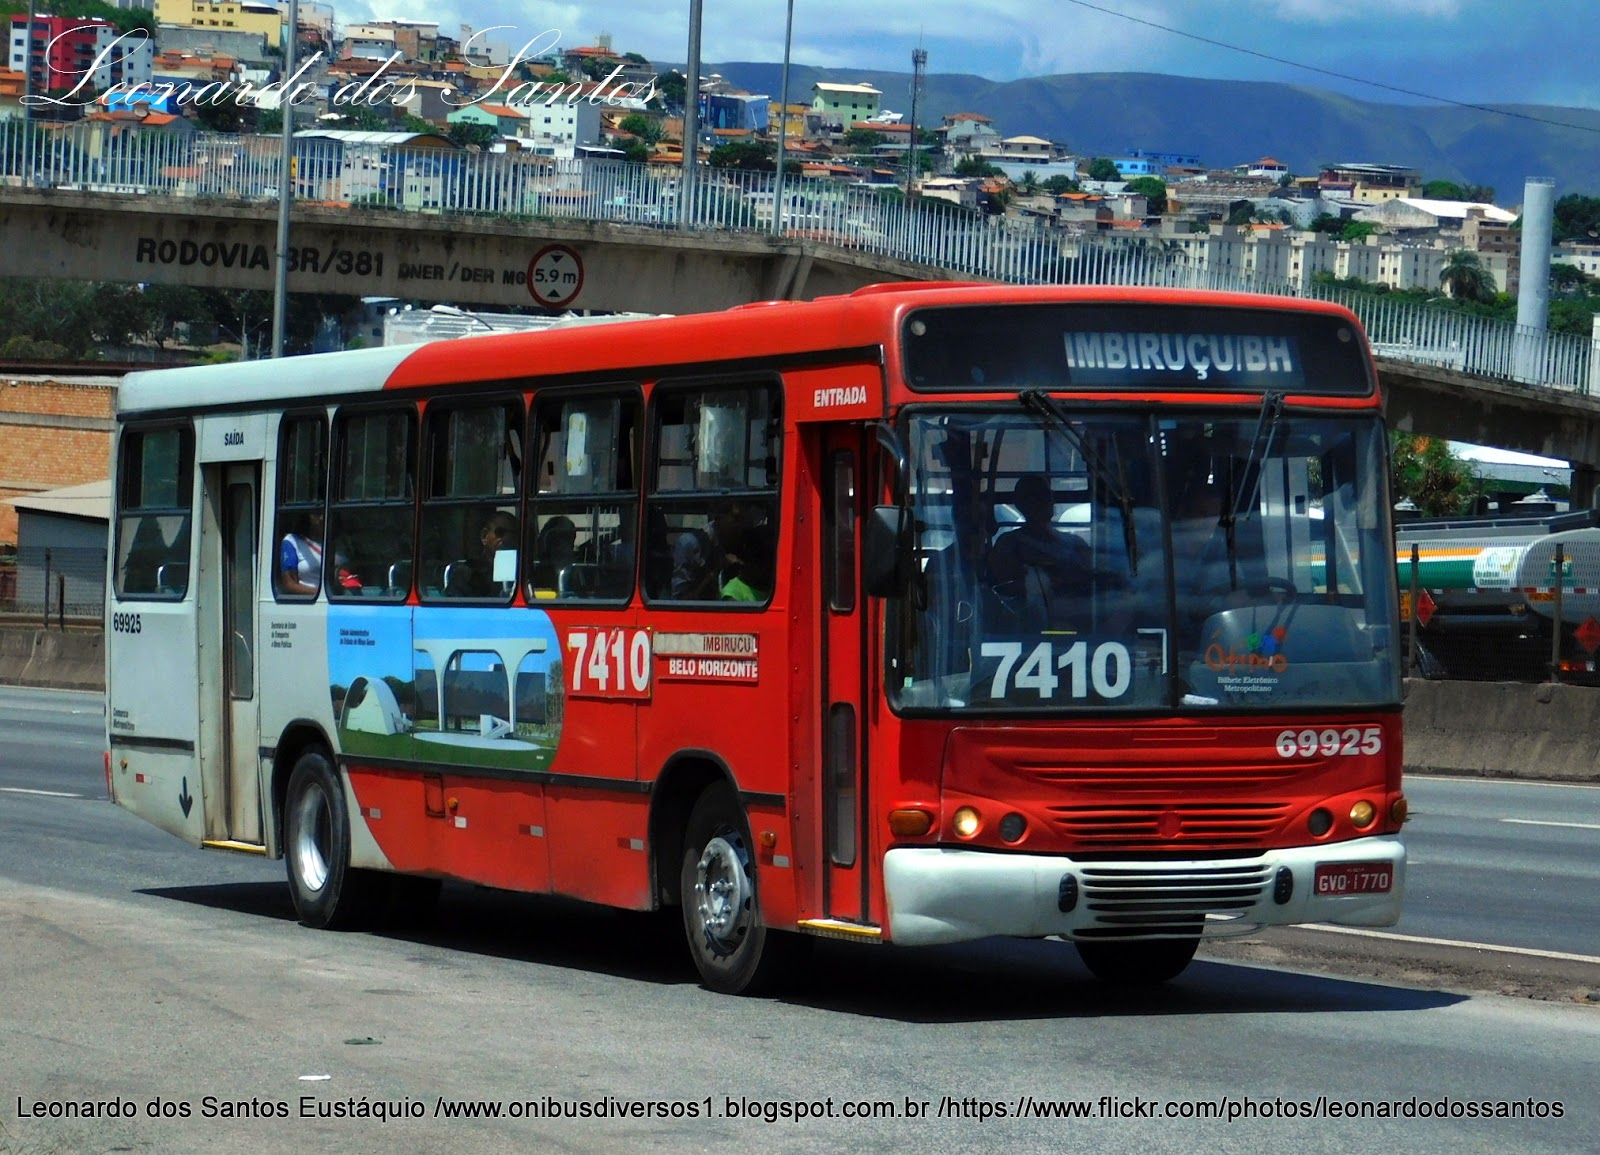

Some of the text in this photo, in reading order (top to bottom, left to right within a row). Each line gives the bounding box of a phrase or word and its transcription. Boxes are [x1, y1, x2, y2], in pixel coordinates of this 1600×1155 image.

[136, 237, 270, 271] RODOVIA
[535, 268, 559, 283] 5.9
[813, 385, 867, 408] ENTRADA
[224, 428, 244, 446] SAÍDA
[113, 612, 142, 634] 69925
[568, 630, 650, 692] 7410
[669, 658, 758, 678] BELO HORIZONTE
[981, 641, 1131, 699] 7410
[1224, 684, 1272, 694] Metropolitano
[1276, 728, 1382, 758] 69925
